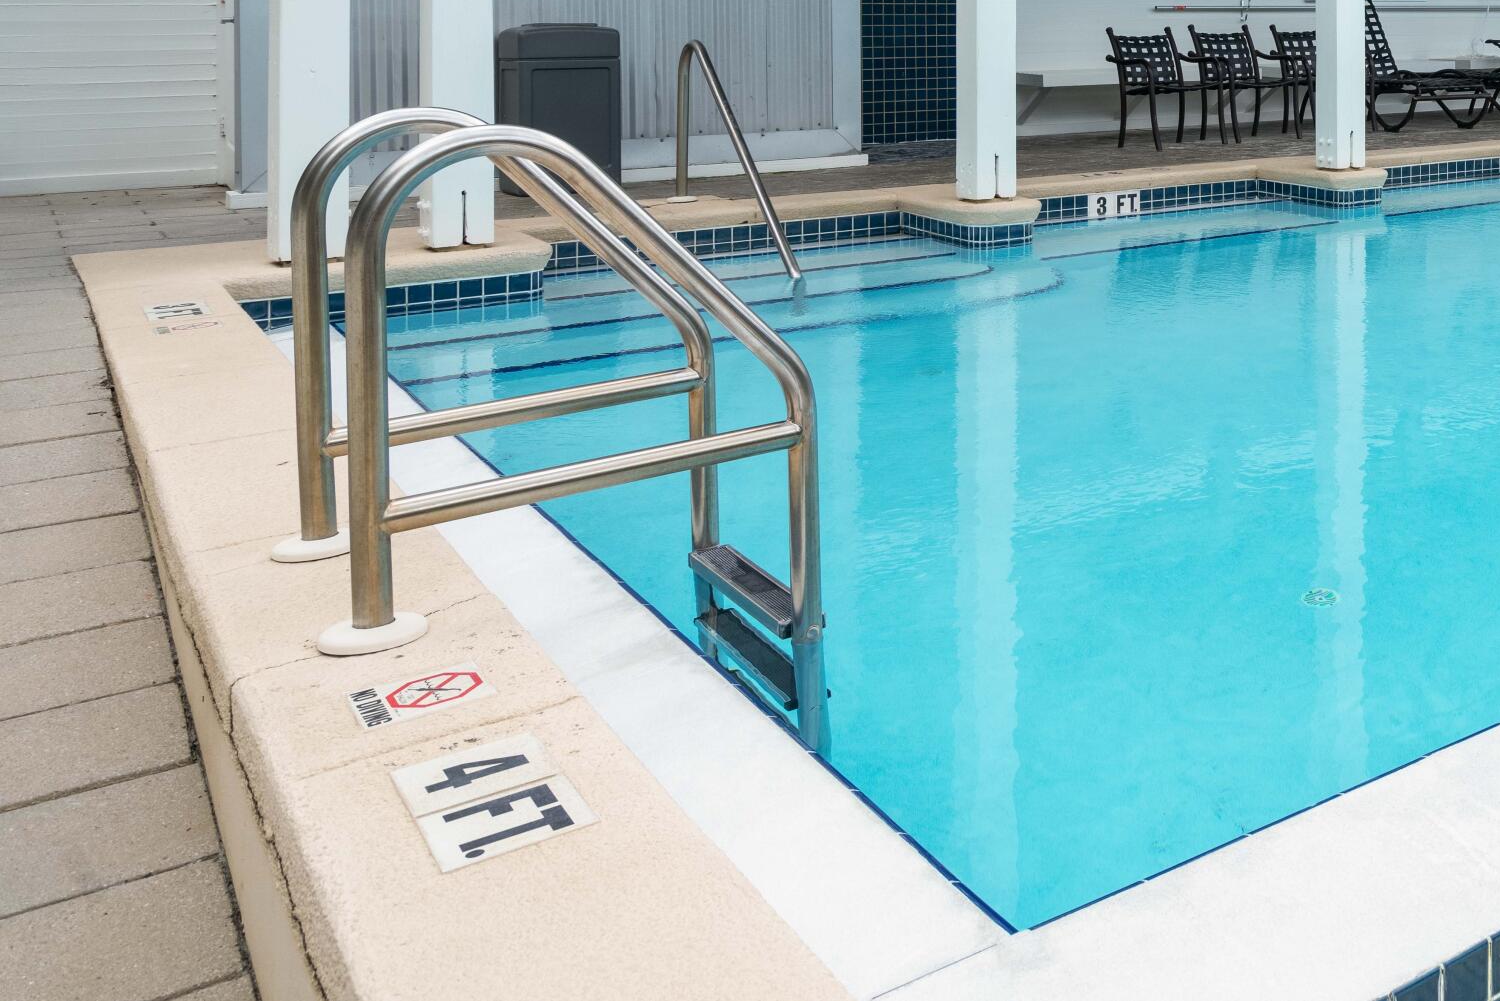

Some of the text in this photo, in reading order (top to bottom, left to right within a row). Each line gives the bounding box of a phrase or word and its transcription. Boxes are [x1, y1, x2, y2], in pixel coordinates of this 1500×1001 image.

[1096, 196, 1107, 216] 3
[349, 687, 393, 728] NO DIVING
[424, 753, 531, 795] 4
